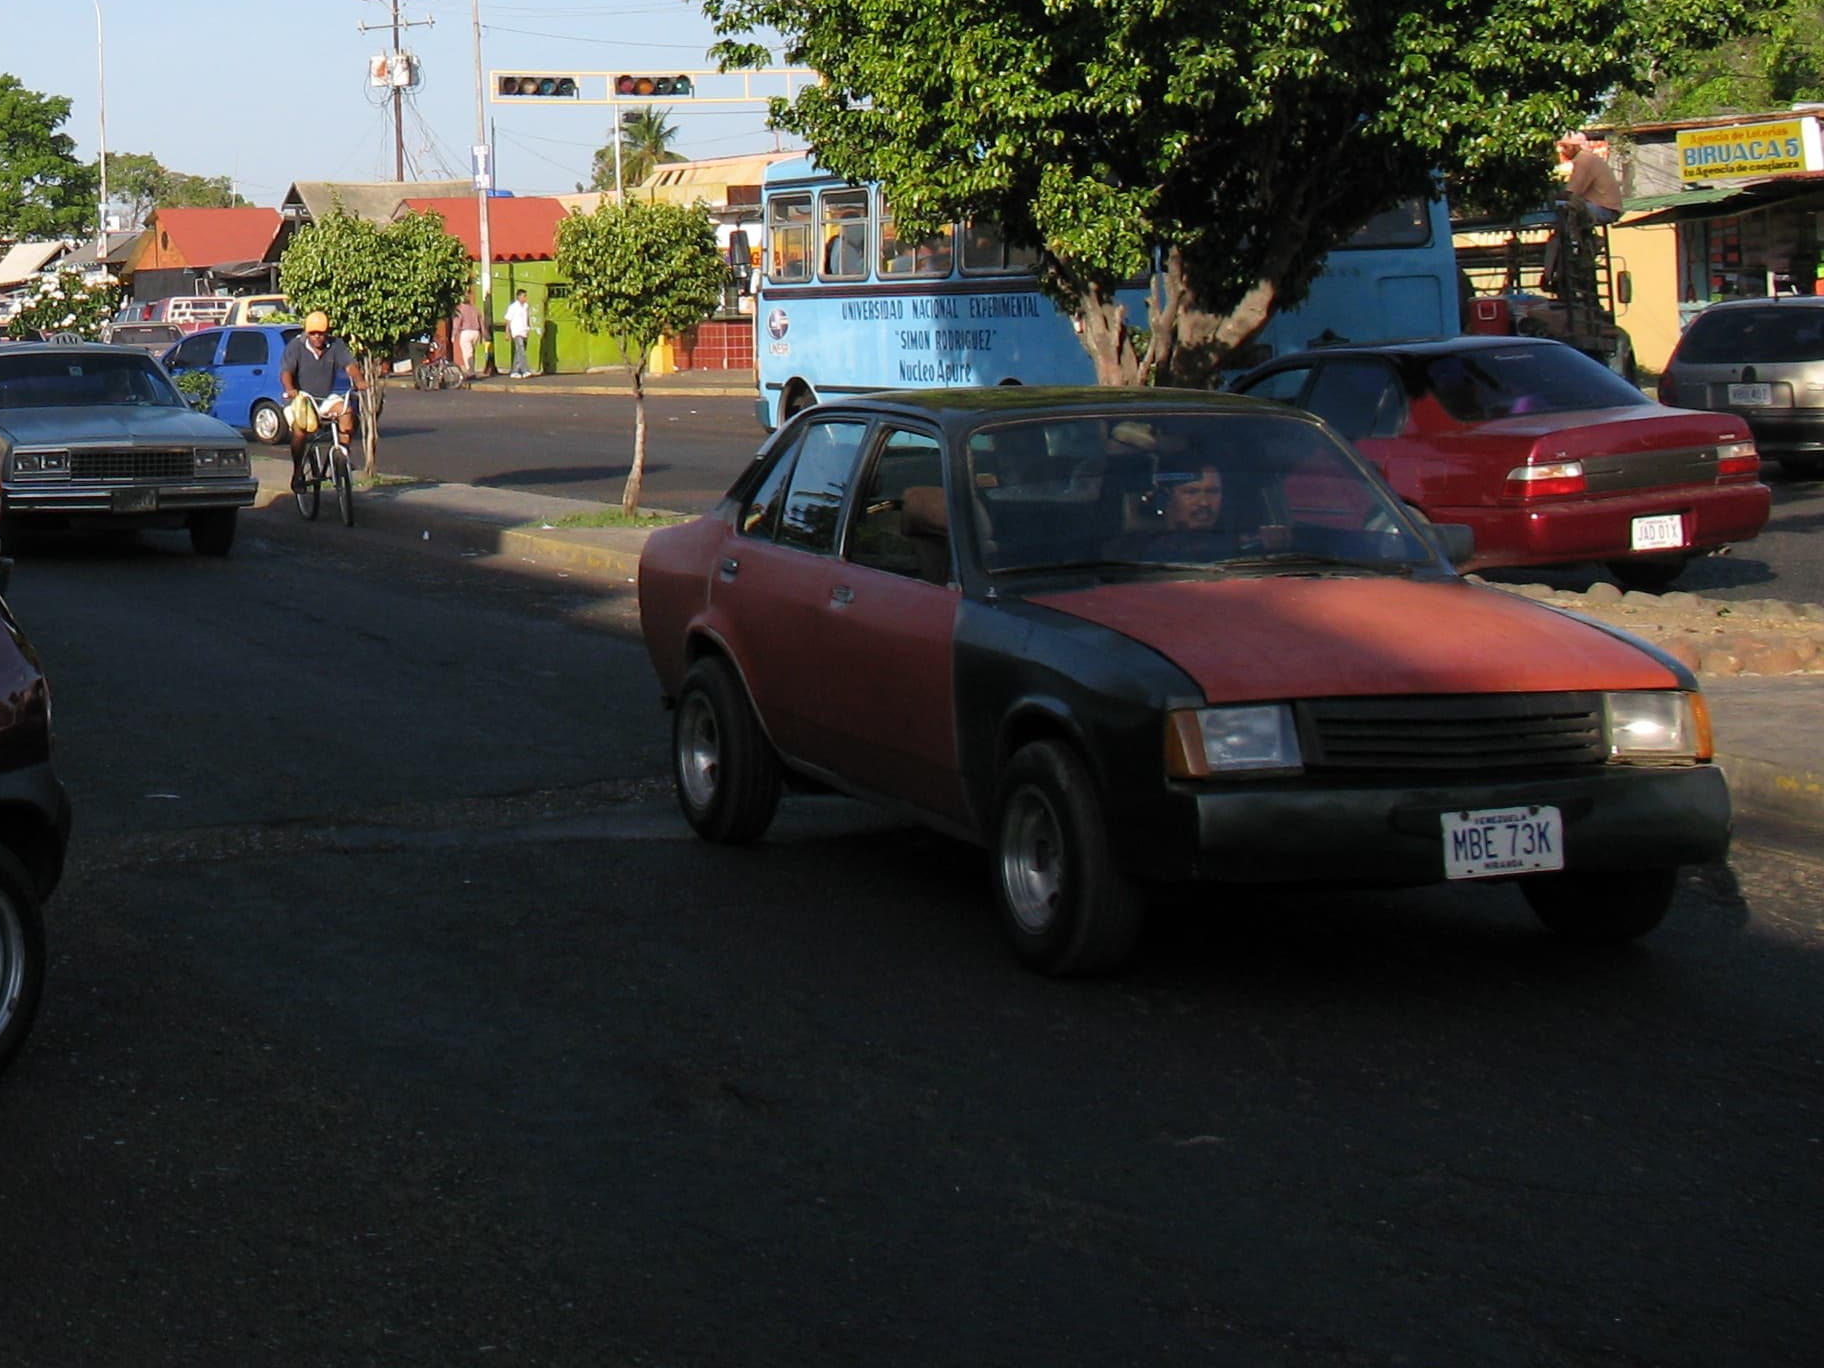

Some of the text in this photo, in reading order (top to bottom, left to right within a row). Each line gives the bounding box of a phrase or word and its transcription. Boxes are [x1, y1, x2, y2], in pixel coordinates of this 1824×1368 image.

[1683, 138, 1800, 166] BIRUACA 5
[841, 295, 1040, 321] UNIVERSIDAD NACIONAL EXPERIMENTAL
[899, 360, 972, 383] Nucleo Apure
[1474, 814, 1527, 825] VENEZUELA
[1452, 821, 1552, 862] MBE 73K
